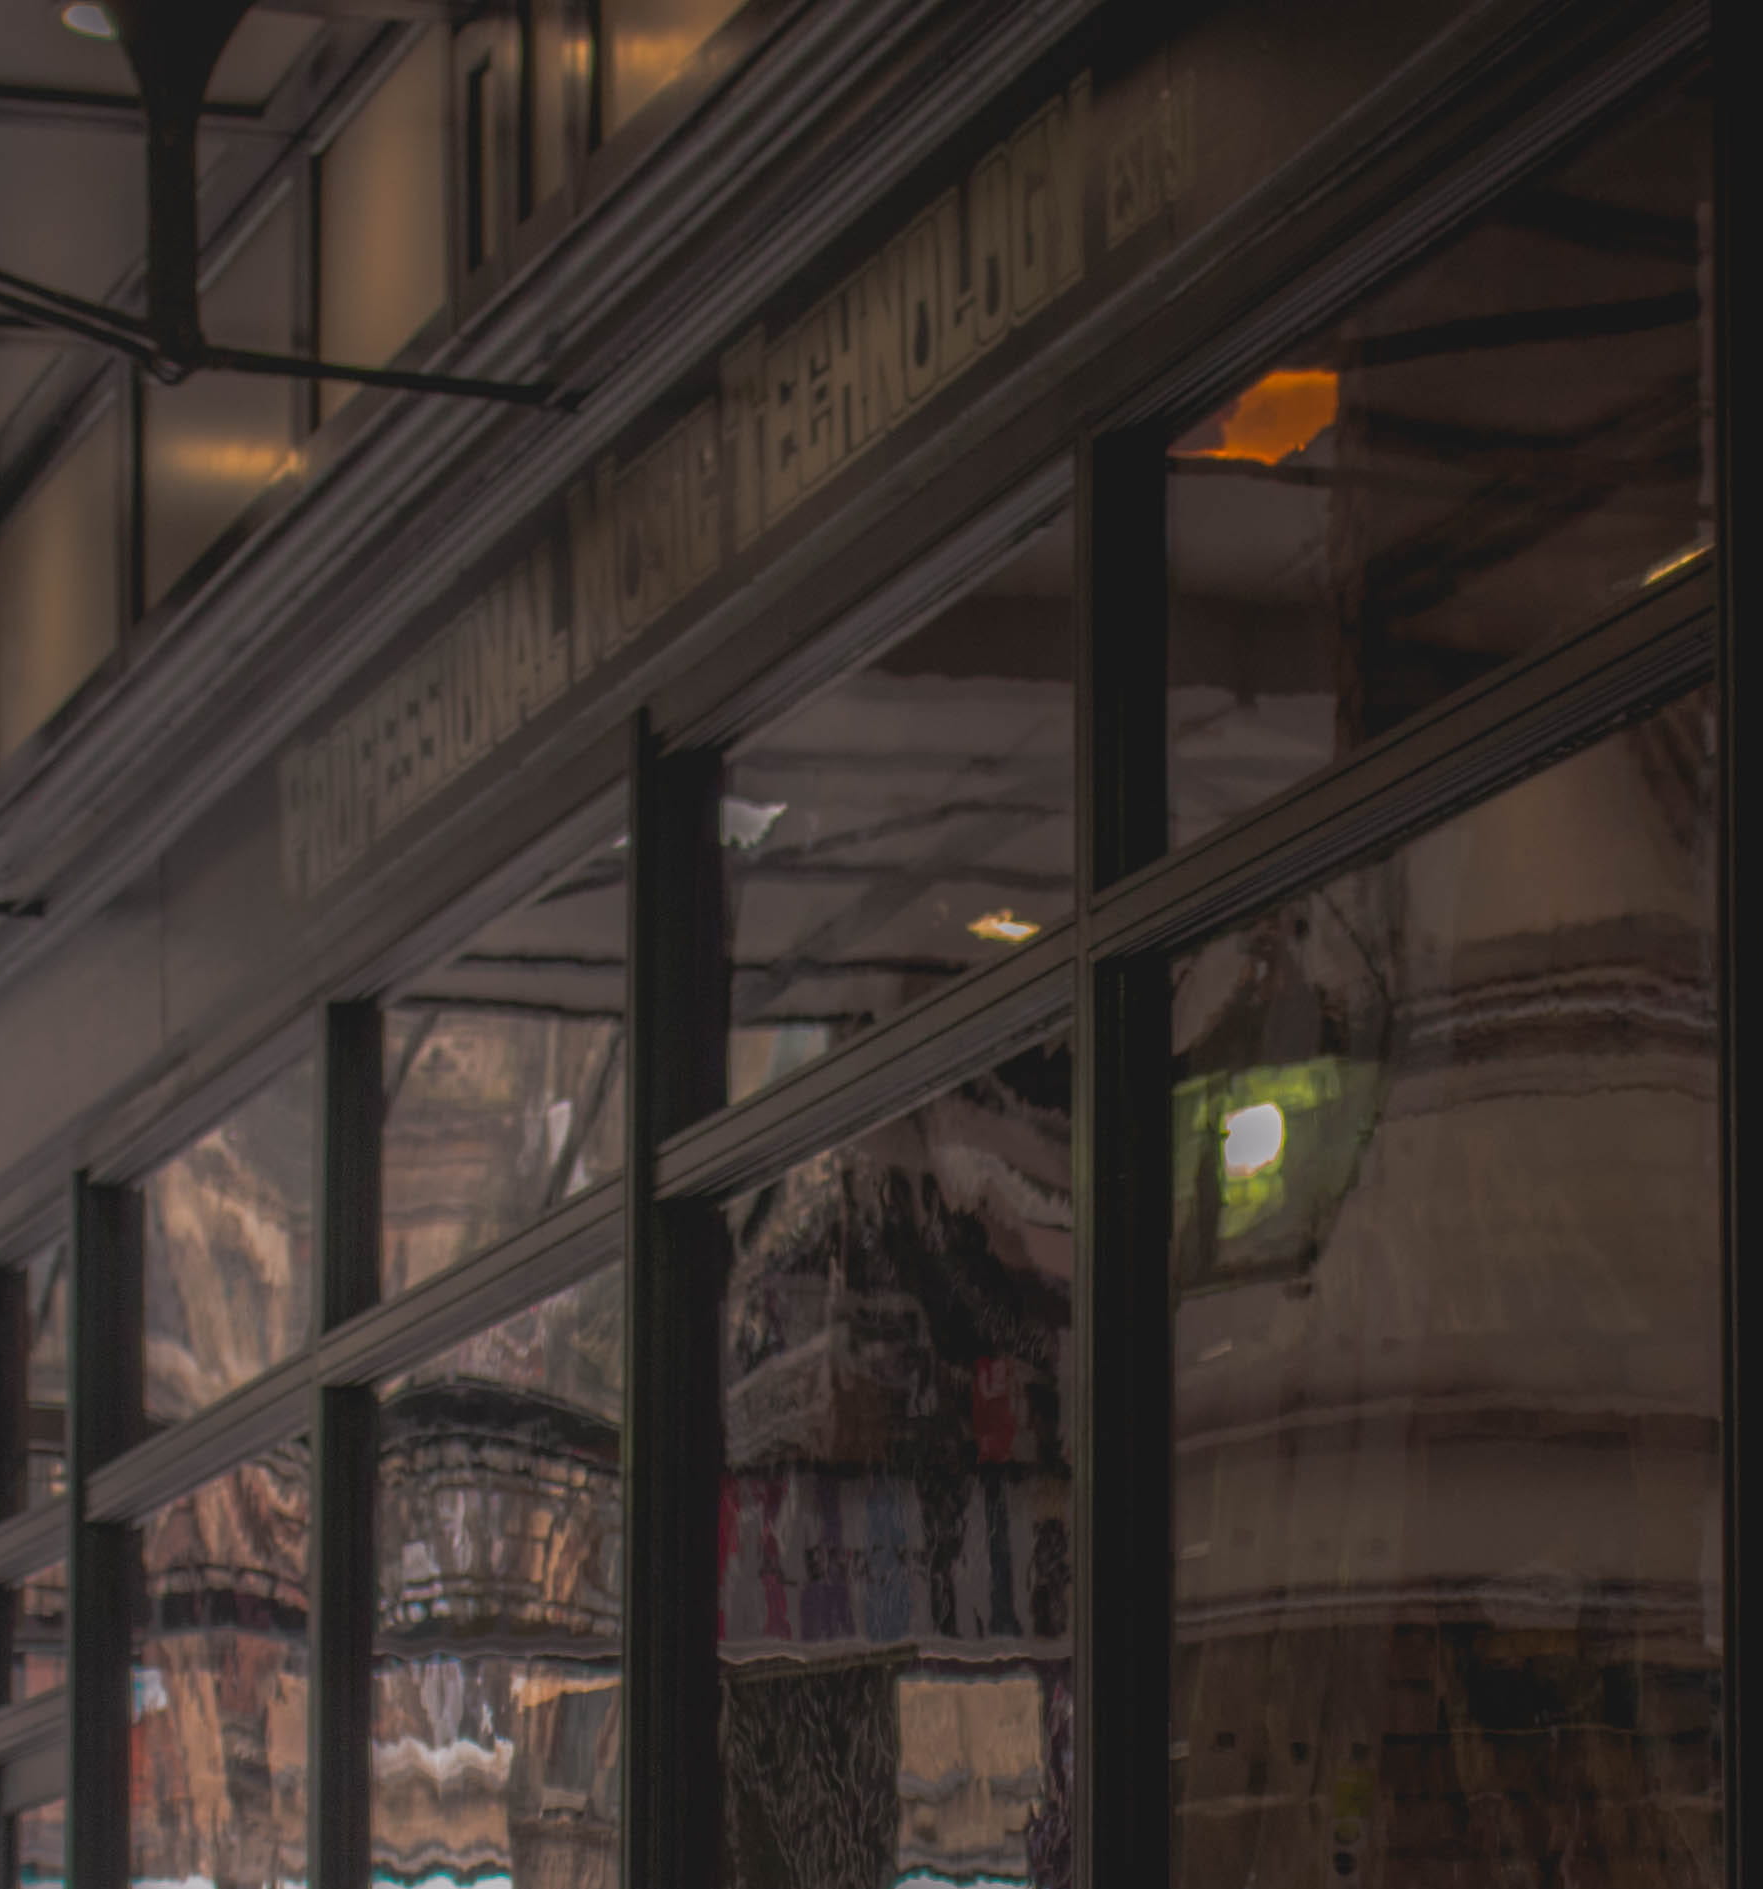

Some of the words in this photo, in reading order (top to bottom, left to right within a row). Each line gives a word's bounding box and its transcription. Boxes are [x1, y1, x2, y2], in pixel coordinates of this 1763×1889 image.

[279, 536, 572, 898] PROFESSIONAL
[570, 394, 723, 685] MUSIC
[720, 66, 1093, 555] TECHNOLOGY
